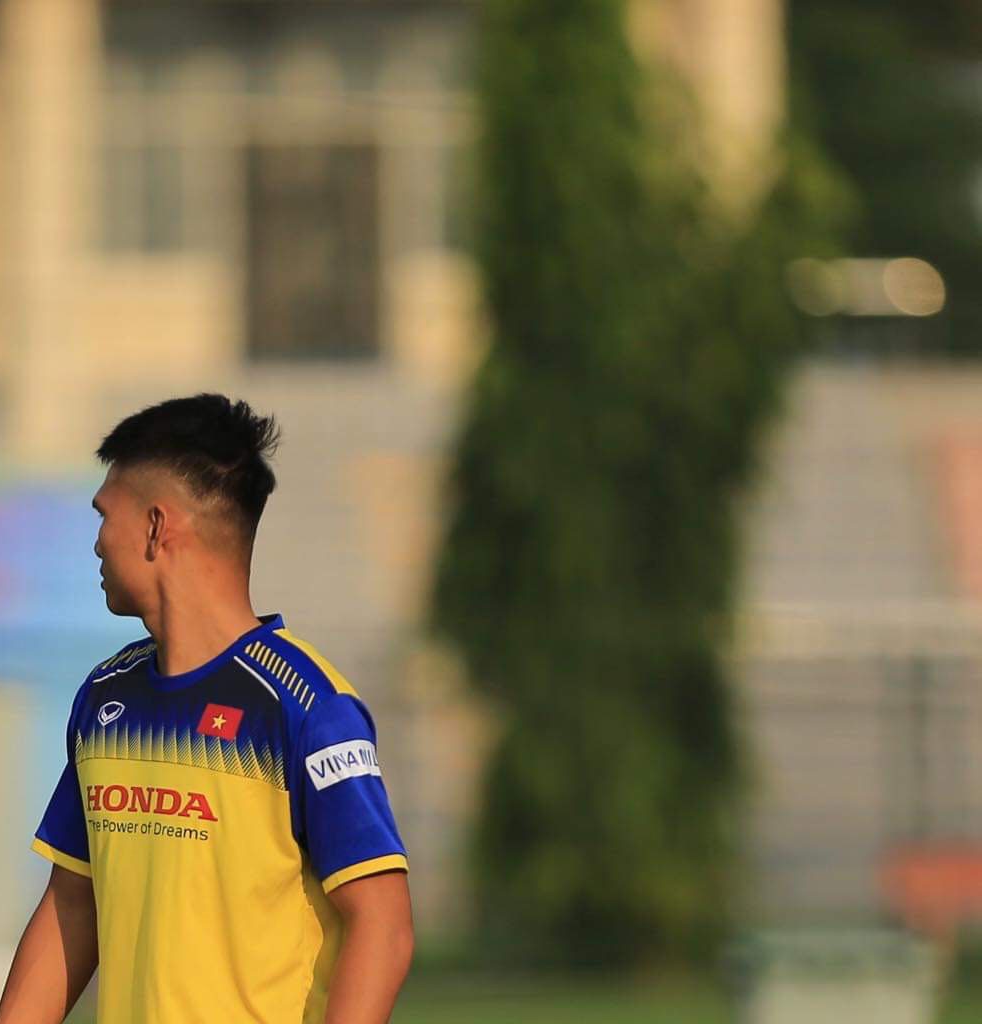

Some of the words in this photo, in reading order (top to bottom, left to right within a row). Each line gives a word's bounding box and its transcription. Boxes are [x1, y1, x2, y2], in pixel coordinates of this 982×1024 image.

[87, 784, 219, 822] HONDA
[102, 819, 138, 834] Power
[140, 822, 153, 835] of
[153, 822, 209, 841] Dreams
